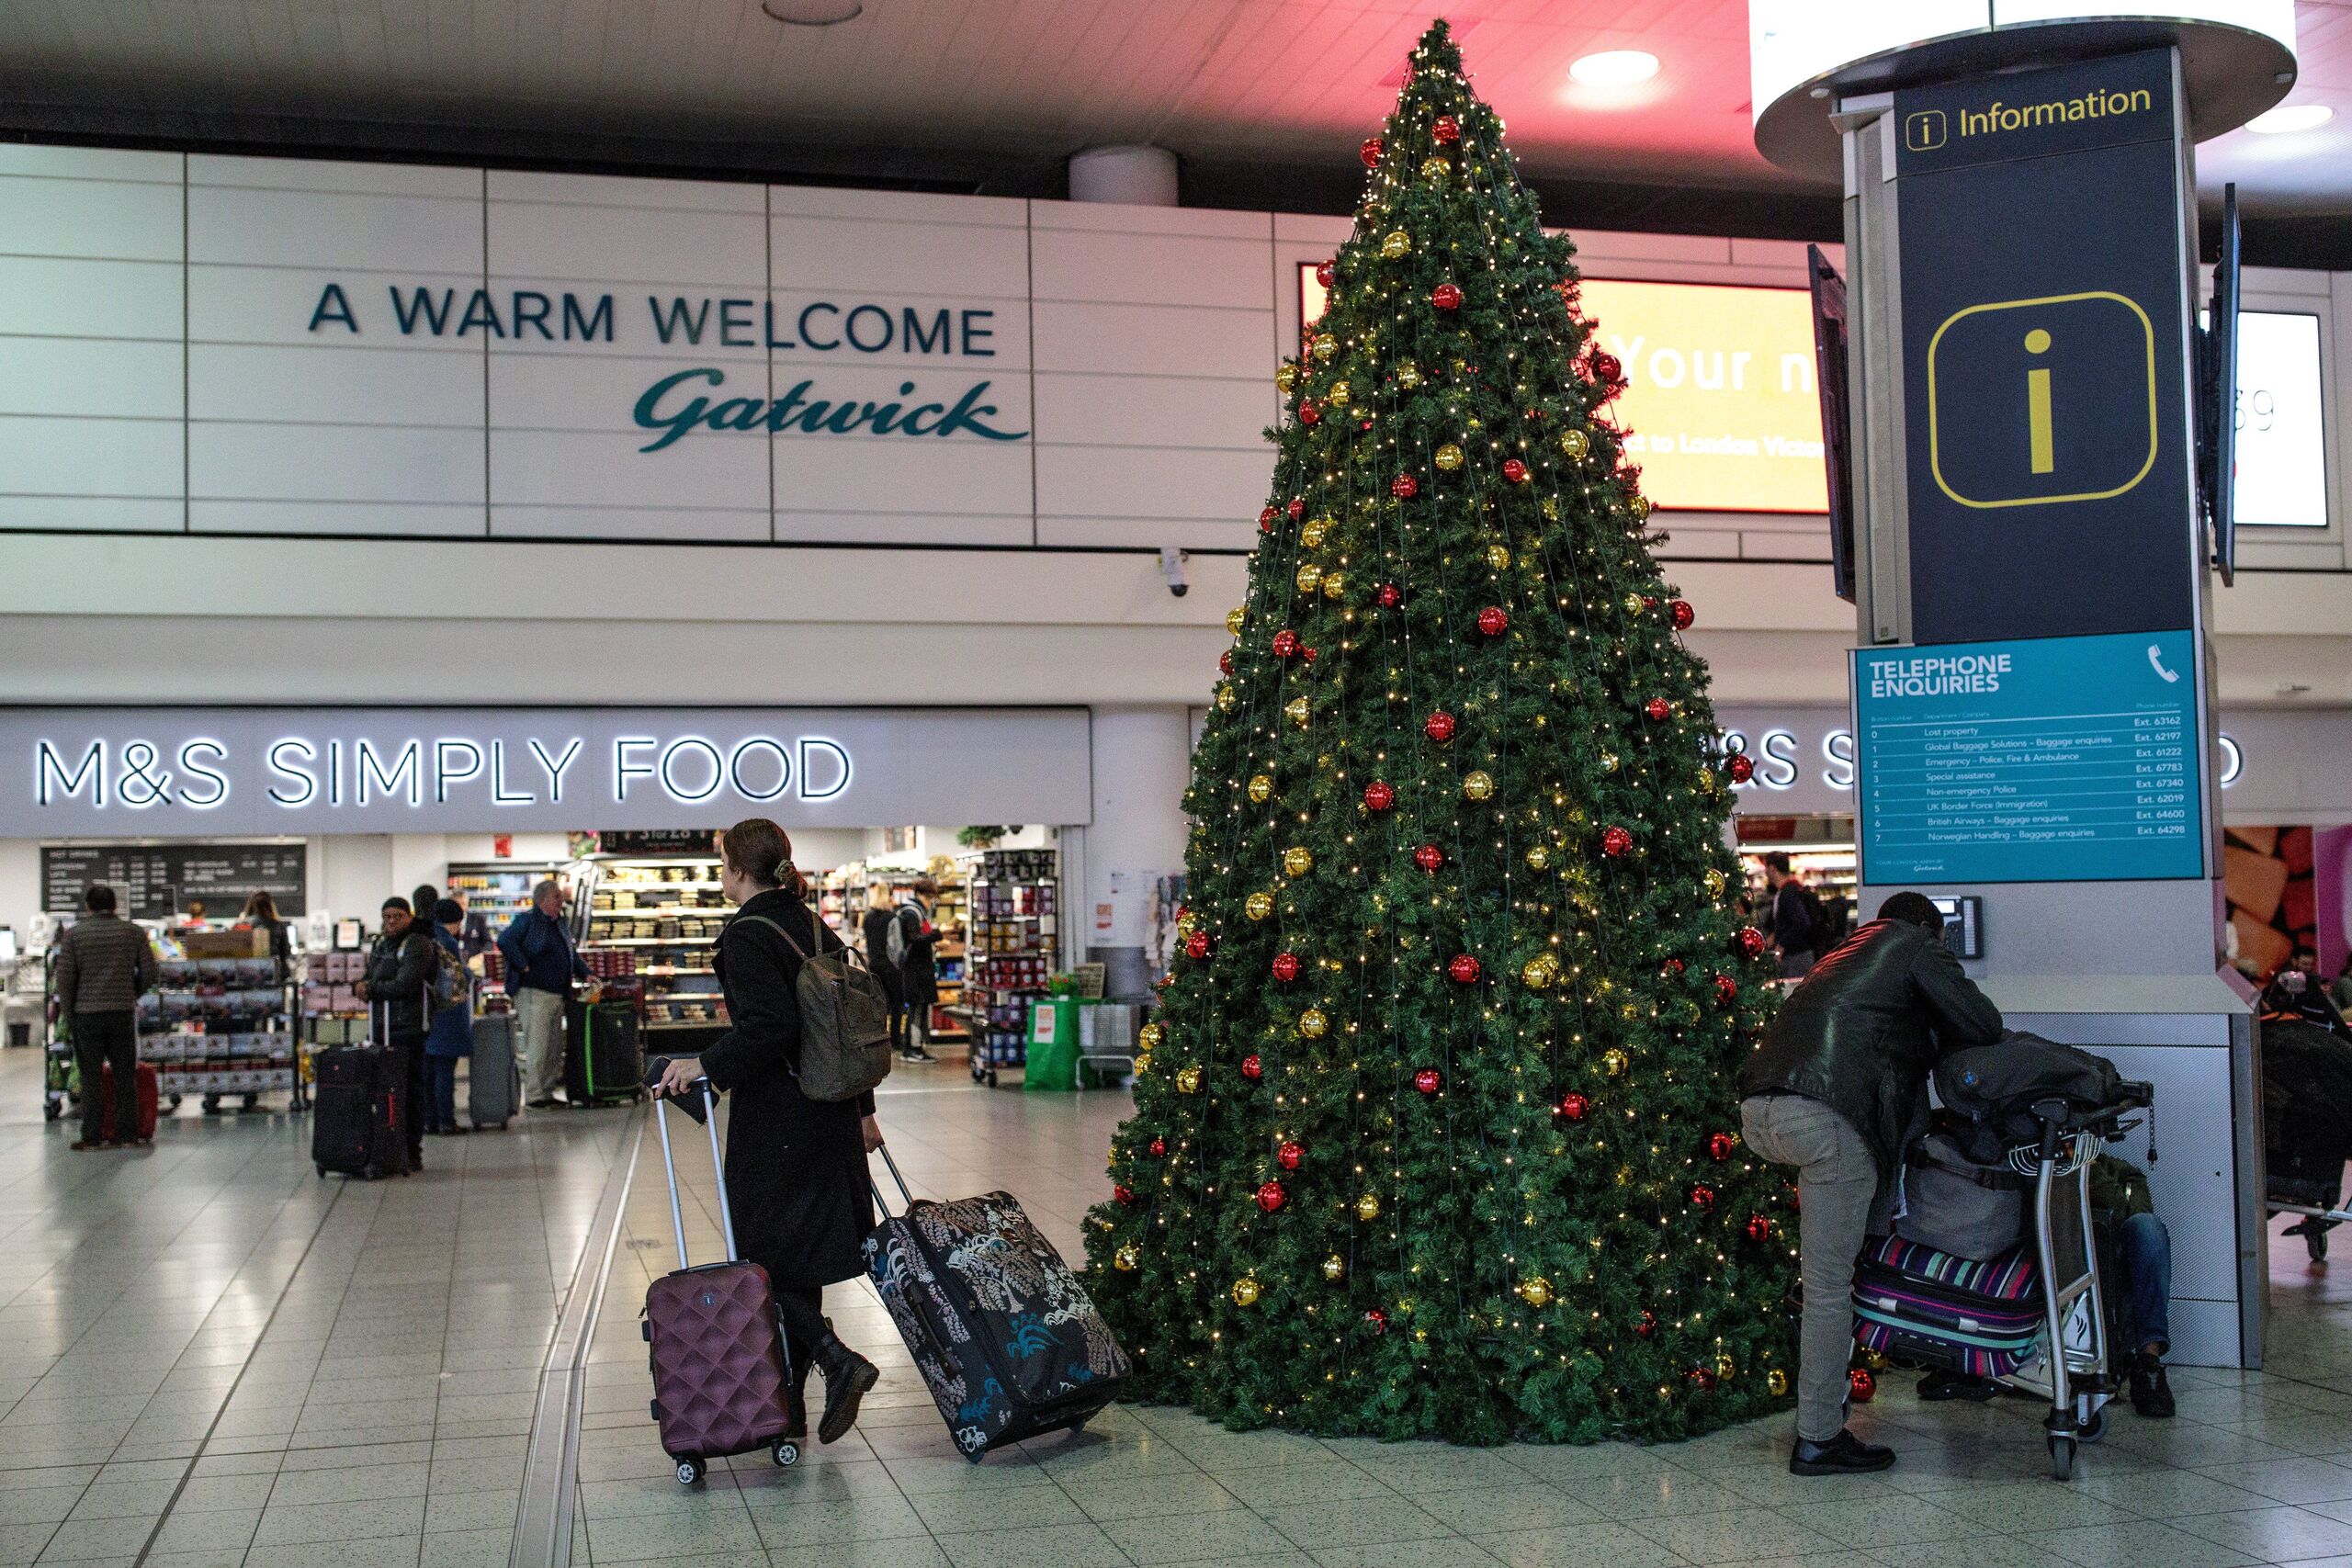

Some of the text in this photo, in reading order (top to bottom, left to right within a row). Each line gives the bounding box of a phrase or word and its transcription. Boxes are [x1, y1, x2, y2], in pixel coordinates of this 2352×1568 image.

[1959, 88, 2152, 137] Information
[308, 282, 997, 356] A WARM WELCOME
[1610, 333, 1752, 391] Your
[632, 367, 1031, 454] Gatwick
[1650, 434, 1676, 454] to
[1679, 432, 1759, 456] London
[1869, 653, 2012, 680] TELEPHONE
[1871, 673, 2000, 698] ENQUIRIES
[1924, 728, 1941, 737] Lost
[1943, 728, 1979, 739] property
[2134, 717, 2152, 727] Ext.
[2154, 716, 2182, 726] 63162
[1925, 742, 1951, 751] Global
[1953, 740, 1989, 753] Baggage
[1991, 739, 2028, 750] Solutions
[2036, 737, 2074, 750] Baggage
[2075, 736, 2113, 747] enquiries
[2135, 734, 2153, 742] Ext.
[2154, 732, 2182, 741] 62197
[1872, 761, 1879, 769] 2
[1925, 757, 1972, 768] Emergency
[2006, 753, 2022, 762] Fire
[2024, 753, 2030, 762] &
[2032, 751, 2080, 762] Ambulance
[2136, 749, 2154, 758] Ext.
[2155, 747, 2182, 757] 61222
[37, 735, 854, 808] M&S SIMPLY FOOD
[1873, 762, 2183, 784] 3 Special assistance Ext. 67783
[1927, 786, 1992, 797] Non-emergency
[1993, 784, 2017, 795] Police
[2136, 779, 2154, 788] Ext.
[2156, 778, 2184, 788] 67340
[1874, 794, 2185, 813] 5 UK Border Force (Immigration) Ext. 62019
[1874, 819, 1881, 828] 6
[1928, 817, 1952, 826] British
[1954, 816, 1985, 827] Airways
[1994, 815, 2030, 827] Baggage
[2032, 814, 2070, 825] enquiries
[2136, 810, 2154, 819] Ext.
[2156, 809, 2185, 819] 64600
[1875, 834, 1882, 842] 7
[1928, 831, 1973, 843] Norwegian
[1974, 829, 2010, 842] Handling
[2018, 829, 2056, 841] Baggage
[2057, 828, 2096, 840] enquiries
[2137, 826, 2155, 835] Ext.
[2157, 825, 2186, 835] 64298
